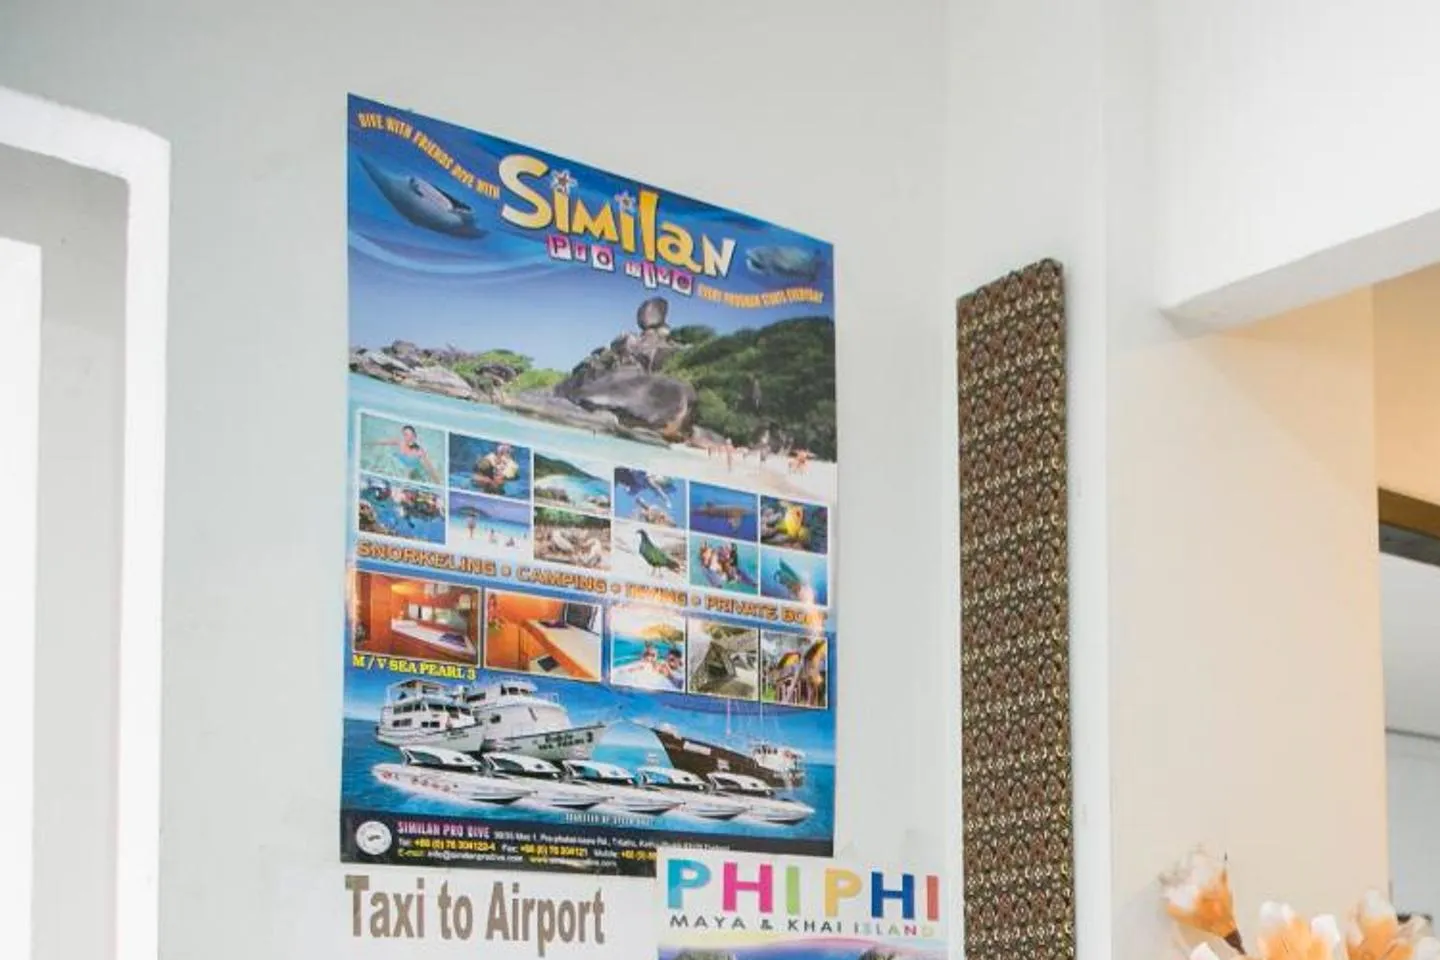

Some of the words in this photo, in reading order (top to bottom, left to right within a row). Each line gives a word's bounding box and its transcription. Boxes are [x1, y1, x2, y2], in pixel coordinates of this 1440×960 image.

[357, 540, 497, 577] SNORKELING
[516, 566, 607, 594] CAMPING
[706, 594, 778, 621] PRIVATE
[390, 659, 418, 674] SEA
[420, 663, 465, 680] PEARL
[397, 821, 440, 836] SIMILAN
[443, 824, 463, 837] PRO
[345, 874, 425, 938] Taxi
[438, 886, 473, 941] to
[485, 881, 605, 957] Airport
[669, 915, 746, 930] MAYA
[760, 919, 774, 930] &
[787, 918, 842, 933] KHAI
[854, 923, 936, 938] ISLAND
